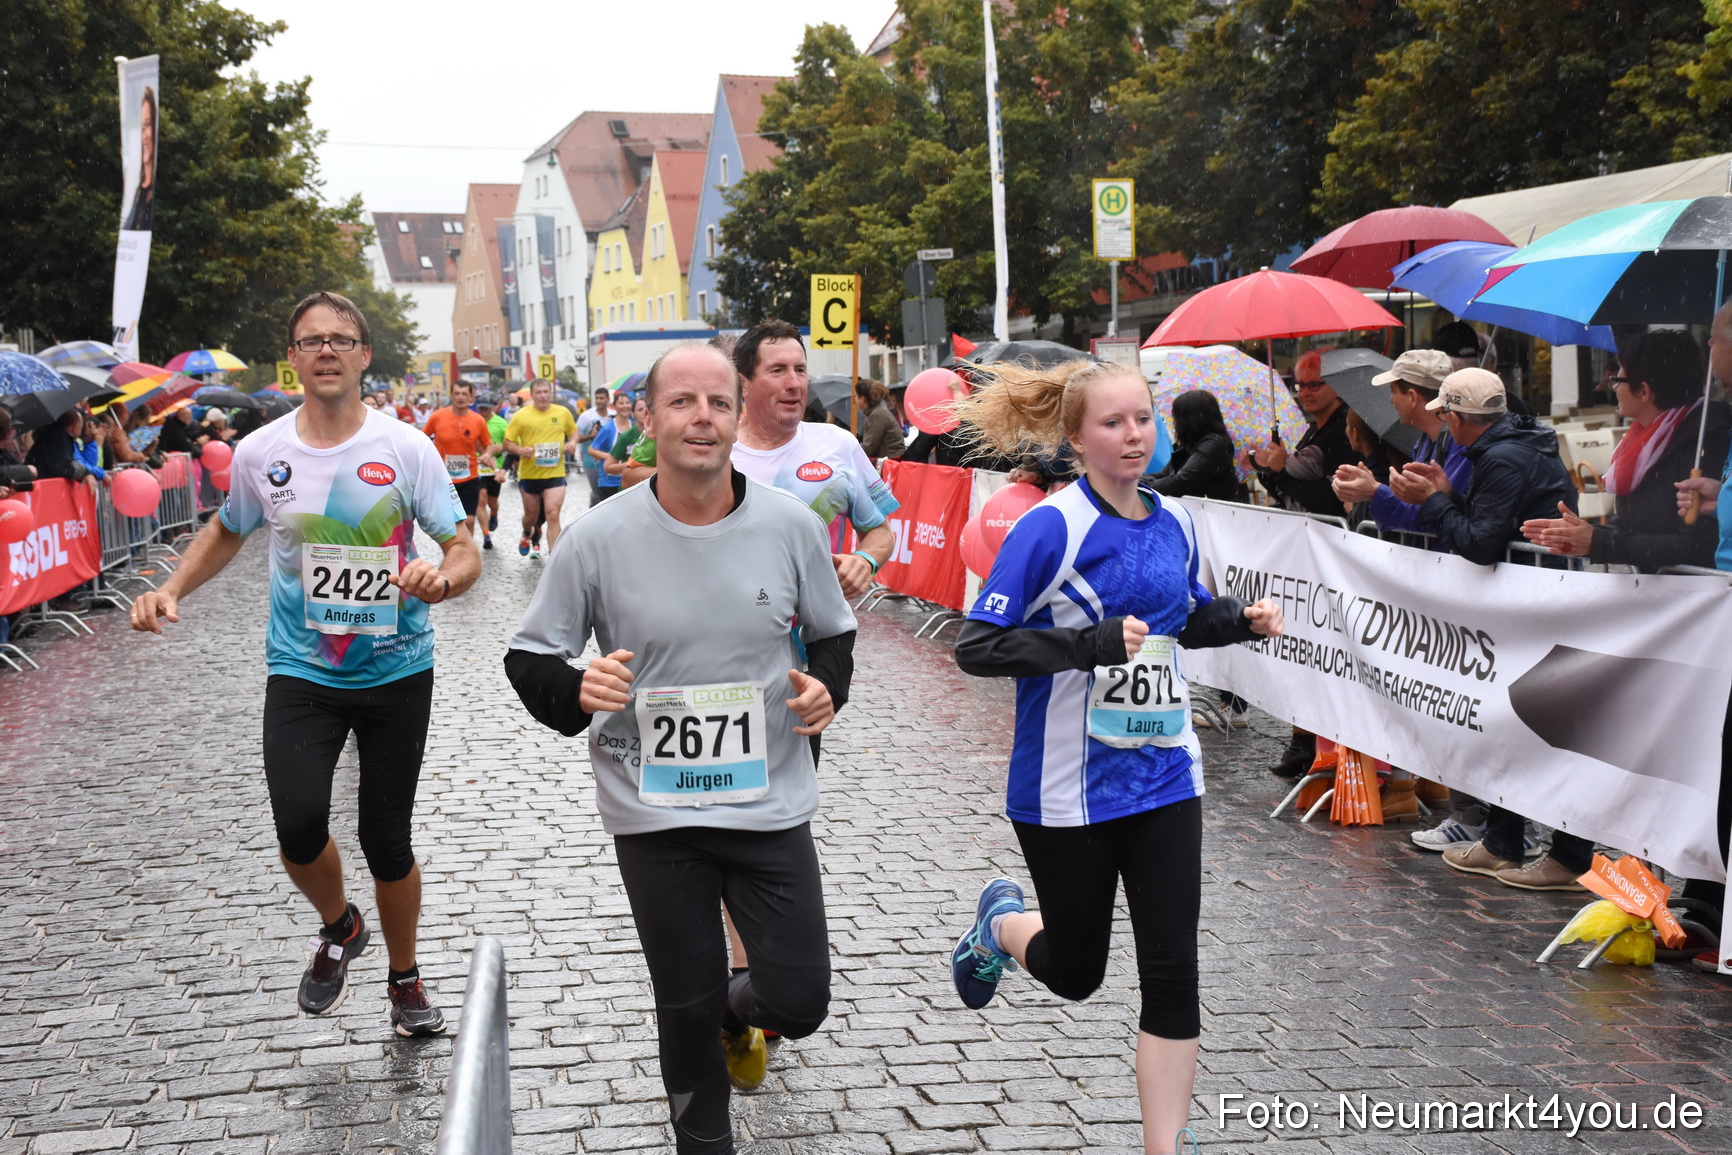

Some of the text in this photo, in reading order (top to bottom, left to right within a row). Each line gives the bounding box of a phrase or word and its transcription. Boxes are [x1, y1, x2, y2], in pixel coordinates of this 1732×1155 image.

[817, 278, 855, 292] Block
[823, 297, 847, 334] C
[283, 370, 294, 385] D
[542, 363, 552, 378] D
[538, 448, 559, 459] 2796
[447, 460, 468, 470] 2096
[801, 466, 830, 477] Hervis
[363, 467, 392, 480] Hervis
[270, 489, 296, 501] PARTL
[348, 549, 392, 561] BOCK
[312, 566, 391, 602] 2422
[324, 608, 376, 624] Andreas
[1103, 664, 1182, 705] 2672
[1273, 633, 1356, 681] VERBRAUCH.
[1384, 671, 1484, 733] FAHRFREUDE.
[646, 700, 686, 709] NeuerMarkt
[693, 686, 755, 705] BOCK
[1126, 716, 1165, 733] Laura
[597, 733, 641, 751] Das Zi
[653, 711, 751, 760] 2671
[612, 749, 629, 764] ist
[676, 771, 733, 791] Jürgen
[1606, 866, 1647, 907] BRANDING
